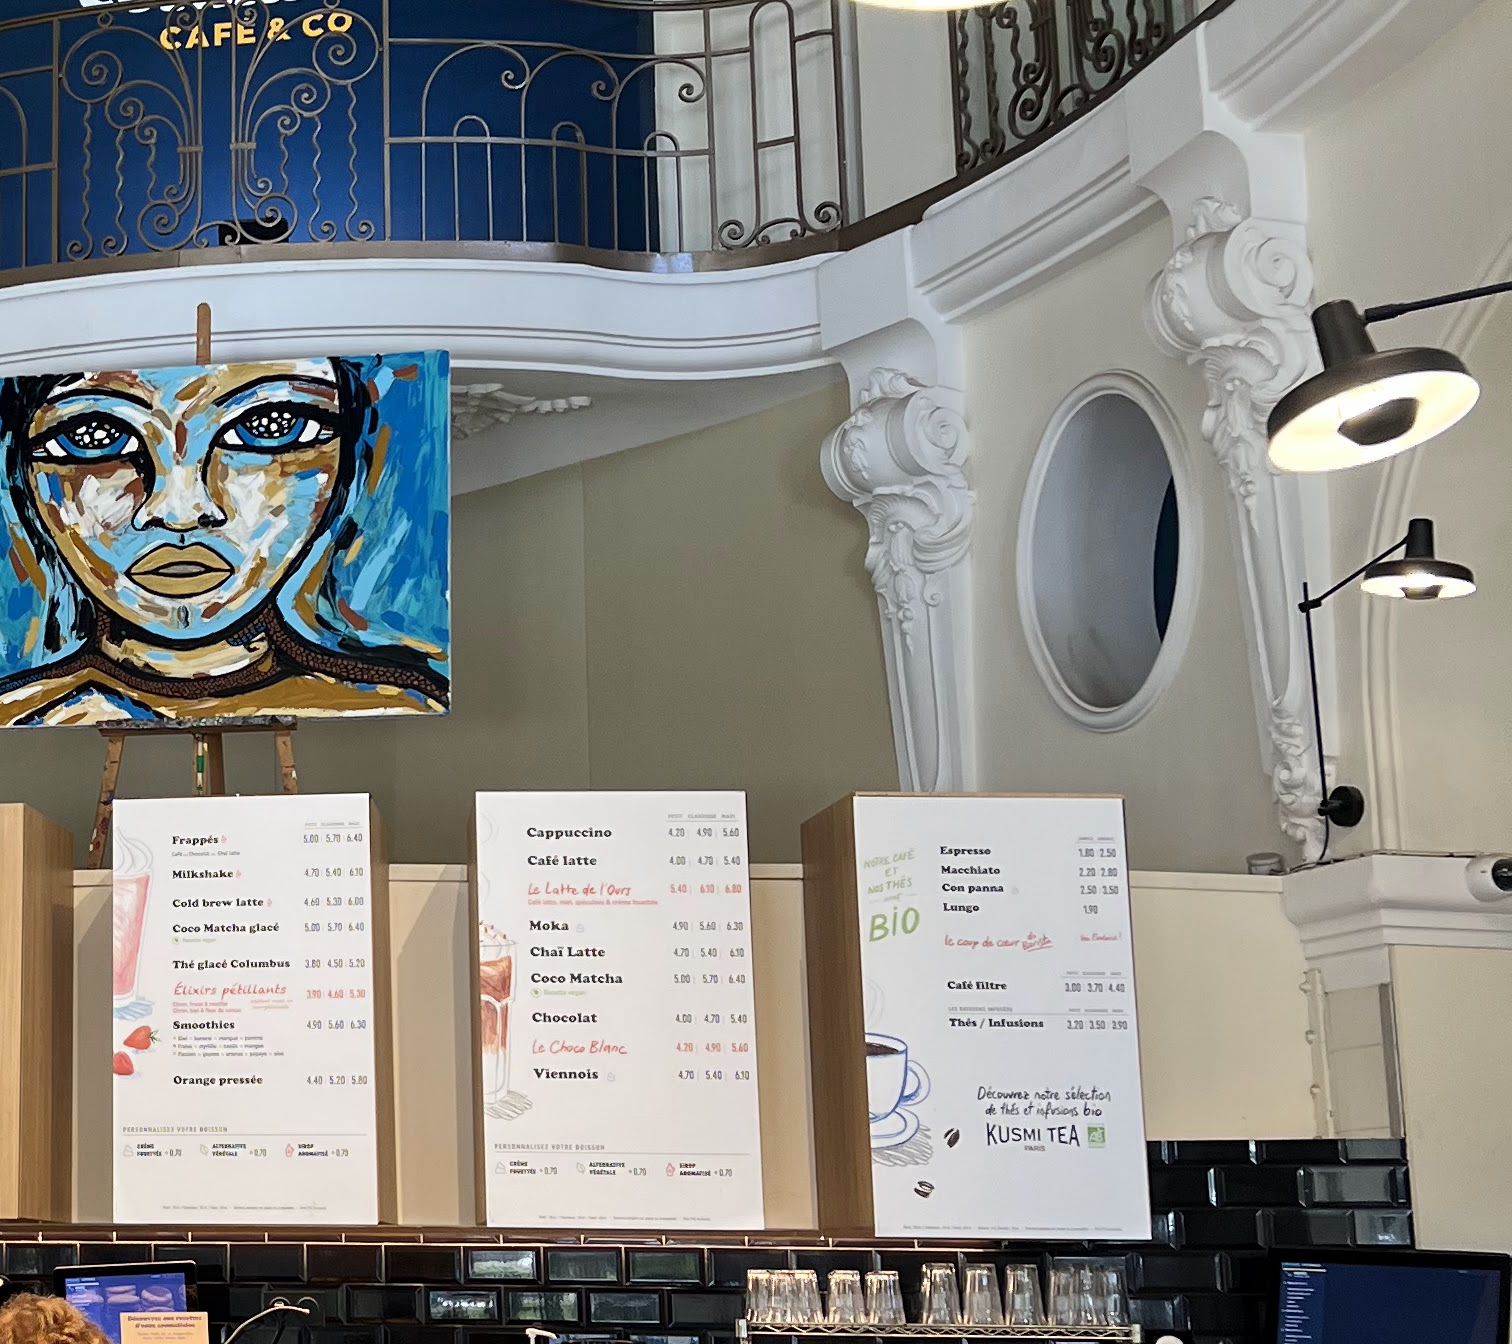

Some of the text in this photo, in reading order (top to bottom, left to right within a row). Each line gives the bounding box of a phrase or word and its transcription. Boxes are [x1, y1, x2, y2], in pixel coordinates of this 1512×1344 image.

[160, 13, 353, 50] CAFÉ & CO
[527, 828, 611, 839] Cappuccino
[172, 835, 218, 845] Frappés
[940, 846, 991, 856] Espresso
[528, 855, 559, 866] Café
[563, 856, 597, 866] latte
[172, 870, 233, 878] Milkshake
[941, 866, 1000, 875] Macchiato
[887, 875, 912, 889] THÉS
[528, 883, 540, 895] Le
[545, 882, 579, 895] Latte
[582, 883, 596, 895] de
[942, 883, 965, 893] Con
[968, 884, 1004, 895] panna
[173, 898, 264, 907] Cold brew latte
[943, 903, 979, 914] Lungo
[173, 923, 279, 933] Coco Matcha glacé
[529, 921, 569, 931] Moka
[530, 946, 563, 957] Chaï
[567, 947, 605, 957] Latte
[173, 960, 290, 970] Thé glacé Columbus
[531, 973, 565, 984] Coco
[570, 973, 623, 984] Matcha
[174, 981, 287, 1000] Élixirs pétillants
[947, 980, 973, 990] Café
[976, 981, 1007, 990] filtre
[532, 1013, 597, 1024] Chocolat
[950, 1018, 977, 1028] Thés
[988, 1018, 1044, 1028] Infusions
[173, 1021, 235, 1029] Smoothies
[532, 1040, 545, 1054] Le
[550, 1040, 585, 1054] Choco
[589, 1041, 627, 1054] Blanc
[533, 1069, 598, 1079] Viennois
[173, 1076, 216, 1086] Orange
[219, 1075, 263, 1086] pressée
[978, 1086, 1111, 1102] Découvrez notre sélection
[985, 1104, 997, 1115] de
[1000, 1102, 1019, 1115] thés
[1024, 1101, 1034, 1115] et
[1083, 1102, 1102, 1116] bio
[986, 1122, 1080, 1147] KUSMI TEA
